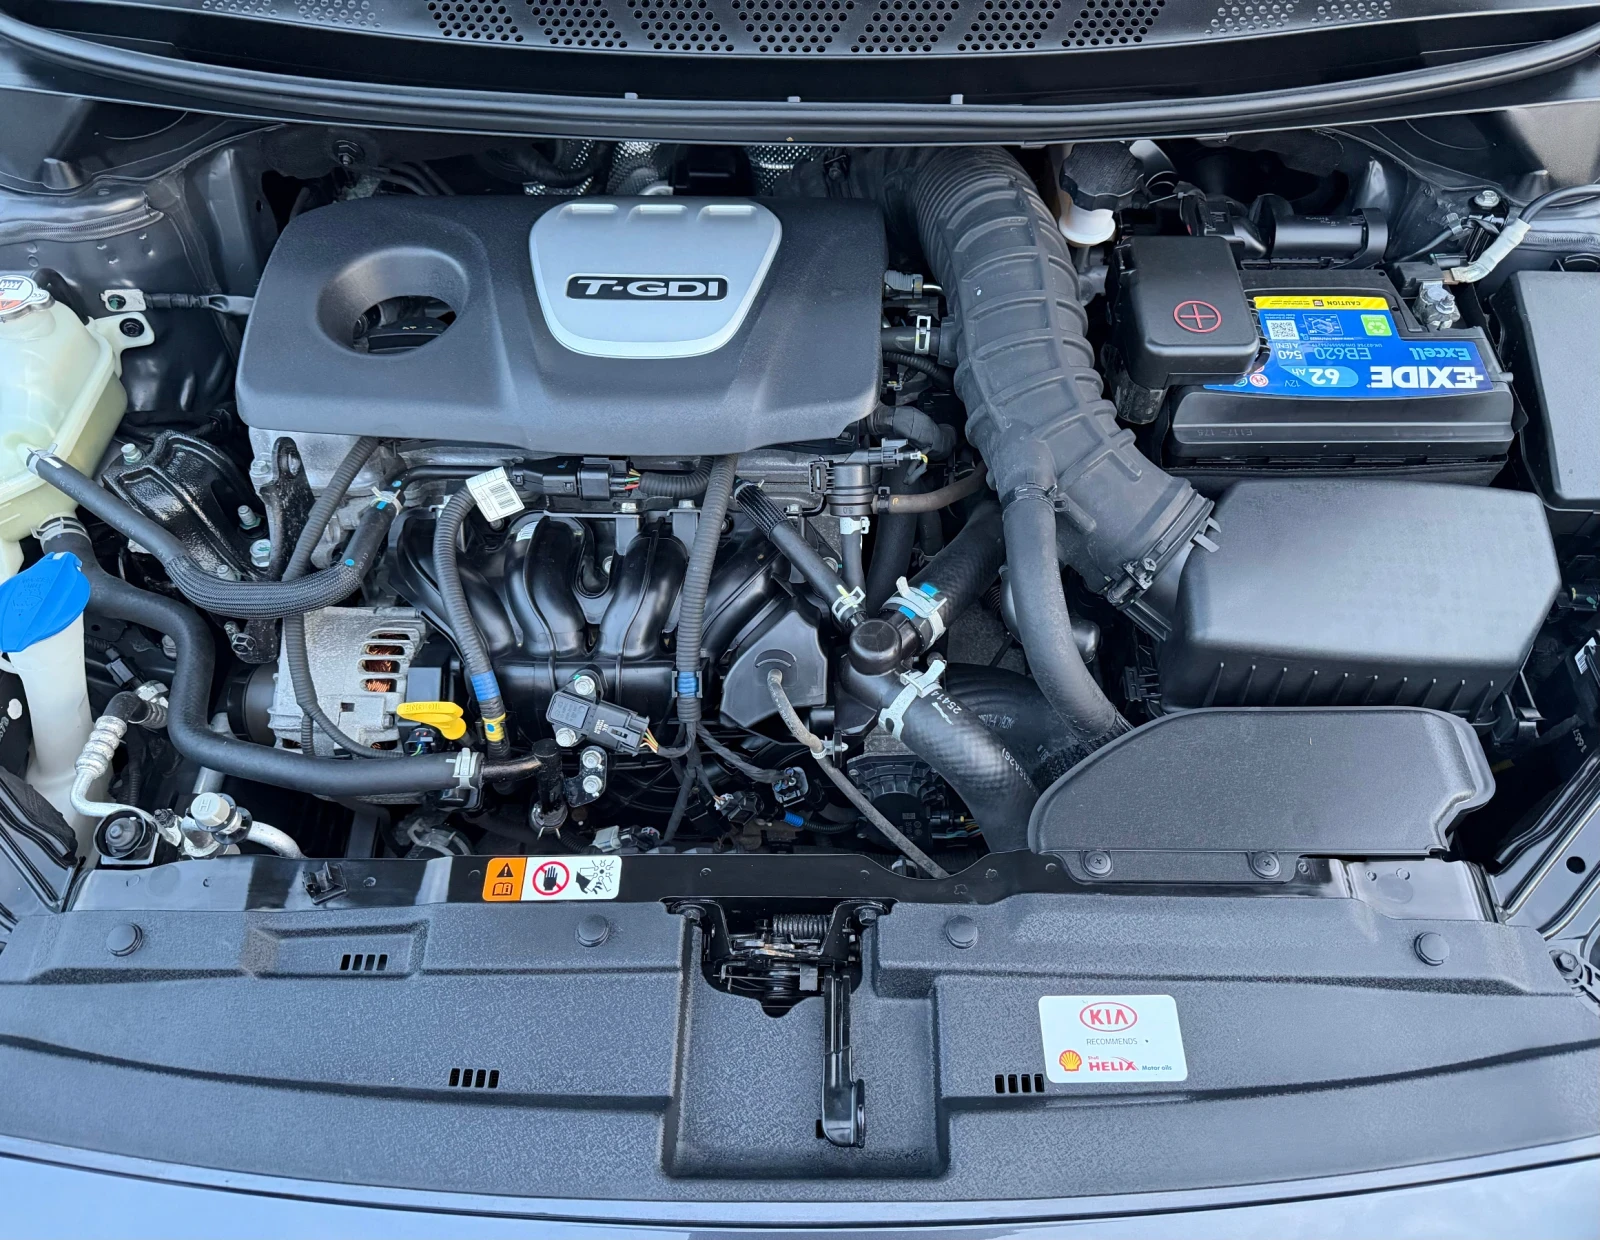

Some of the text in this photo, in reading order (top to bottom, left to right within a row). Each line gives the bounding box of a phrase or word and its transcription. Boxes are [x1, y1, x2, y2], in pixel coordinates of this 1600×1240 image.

[577, 279, 719, 297] T-GDI
[1278, 350, 1303, 360] 540
[1314, 347, 1372, 360] EB620
[1408, 347, 1472, 361] Excell
[1308, 368, 1340, 385] 62
[1369, 366, 1484, 389] EXIDE
[1284, 380, 1301, 388] 12V
[930, 690, 963, 715] 25414
[1088, 1009, 1129, 1025] KIA
[1086, 1037, 1138, 1046] RECOMMENDS
[1088, 1061, 1139, 1072] HELIX
